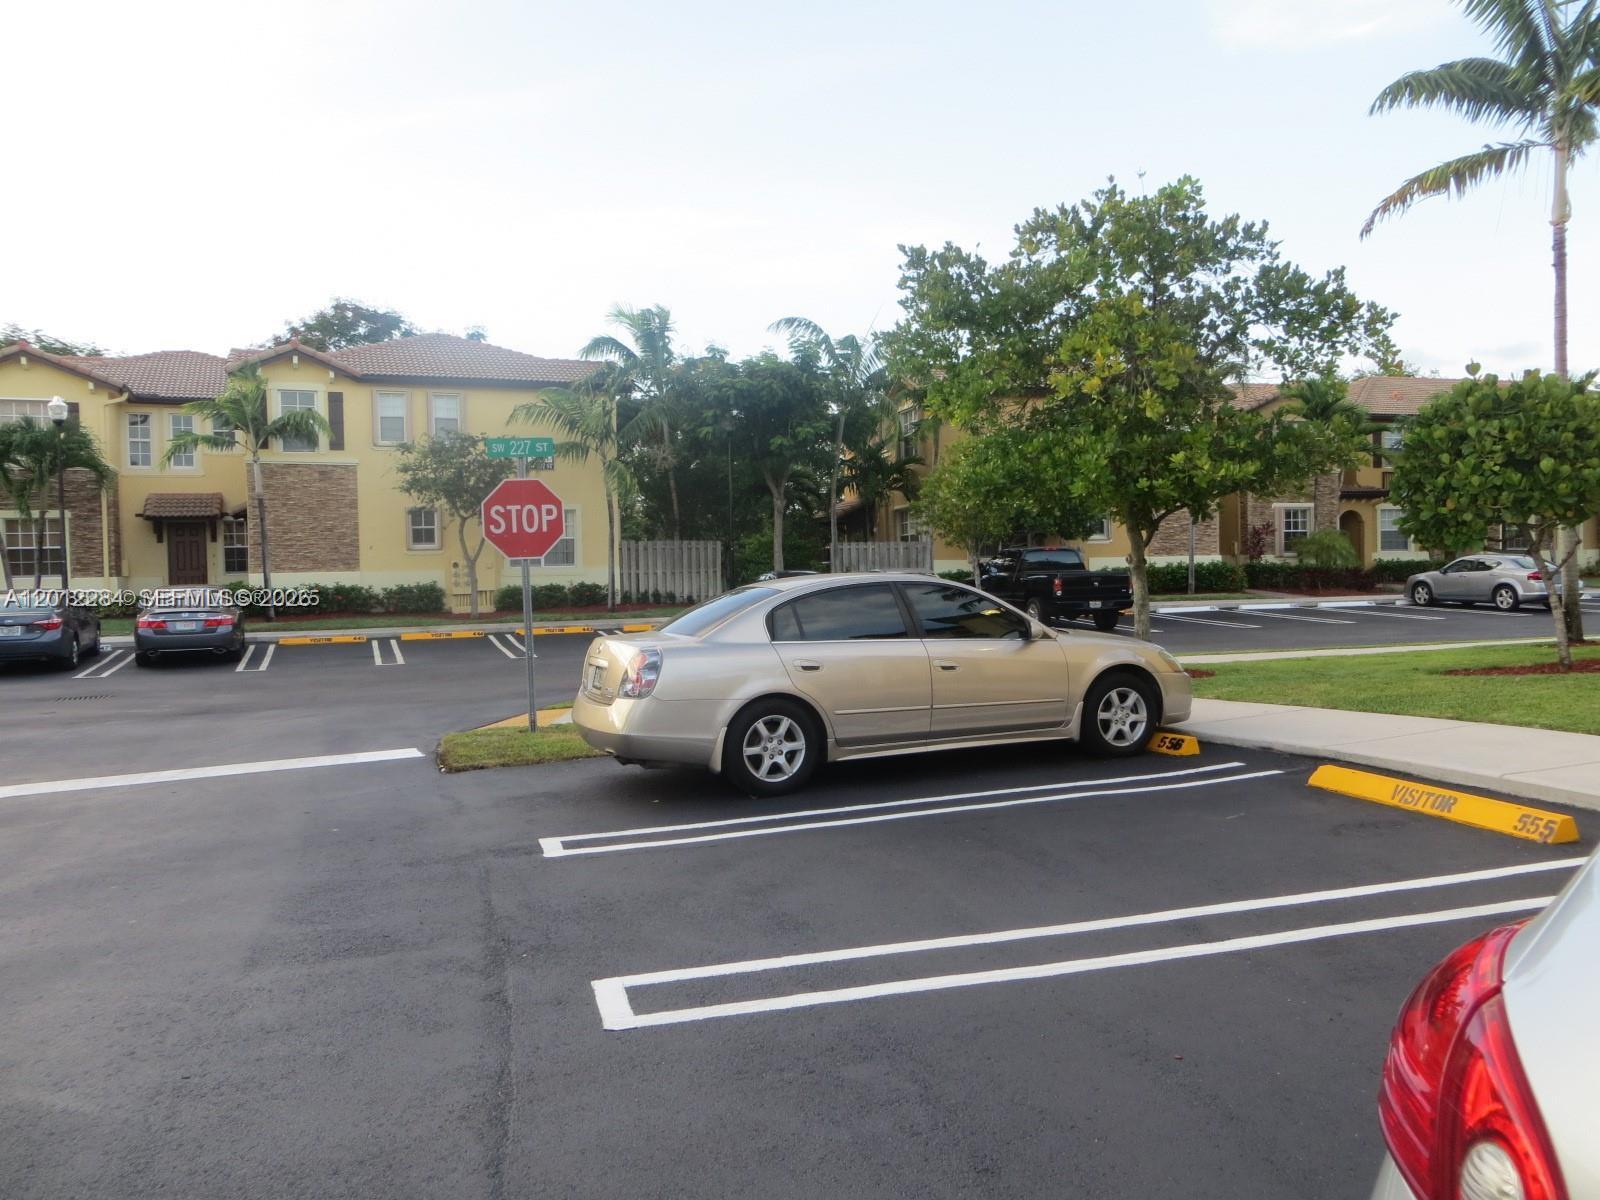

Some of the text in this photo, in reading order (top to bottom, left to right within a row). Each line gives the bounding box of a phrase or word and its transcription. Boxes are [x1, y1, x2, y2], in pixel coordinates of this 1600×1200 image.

[492, 440, 549, 455] SW 227 ST
[489, 504, 558, 534] STOP
[1390, 784, 1557, 843] VISITOR 555
